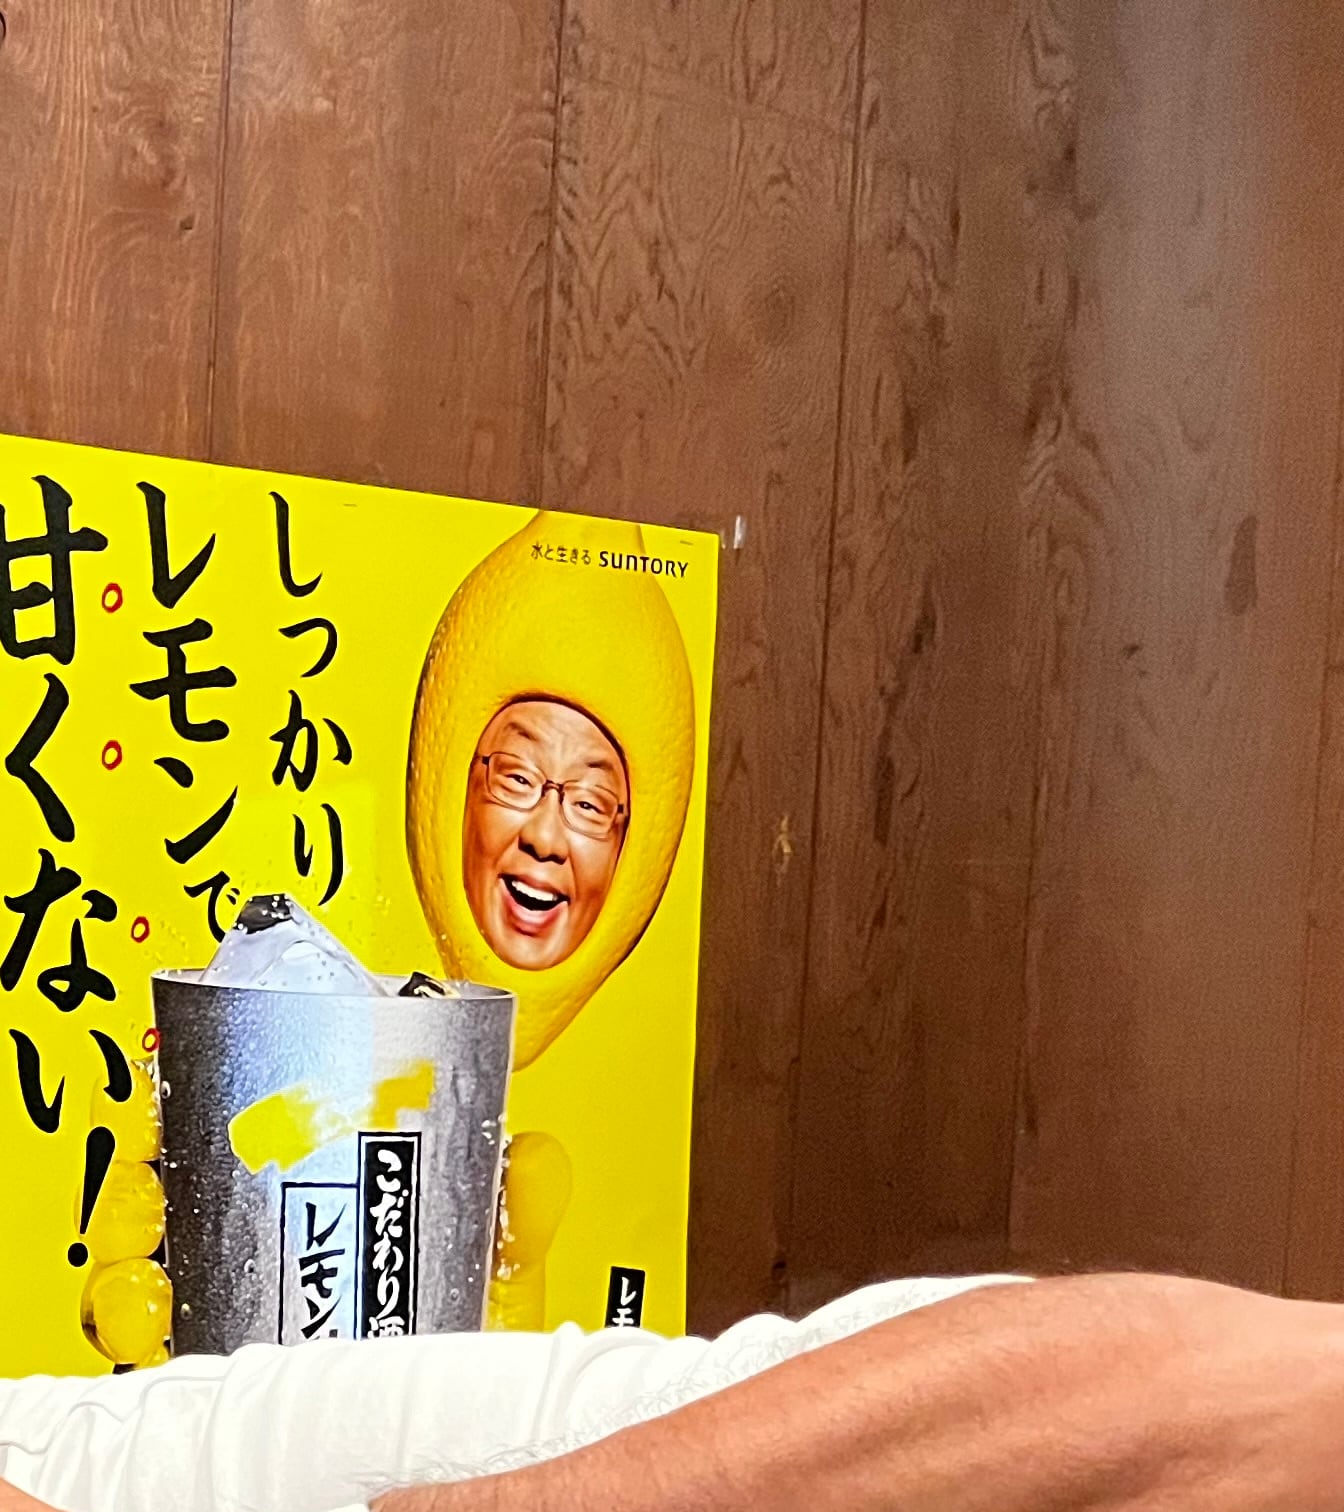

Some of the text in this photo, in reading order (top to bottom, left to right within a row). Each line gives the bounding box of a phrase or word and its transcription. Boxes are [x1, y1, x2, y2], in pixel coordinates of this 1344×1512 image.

[267, 490, 354, 908] しっかり
[530, 542, 689, 578] 水と生きる SUNTORY
[129, 481, 238, 944] レモンで
[299, 1202, 348, 1340] レモン
